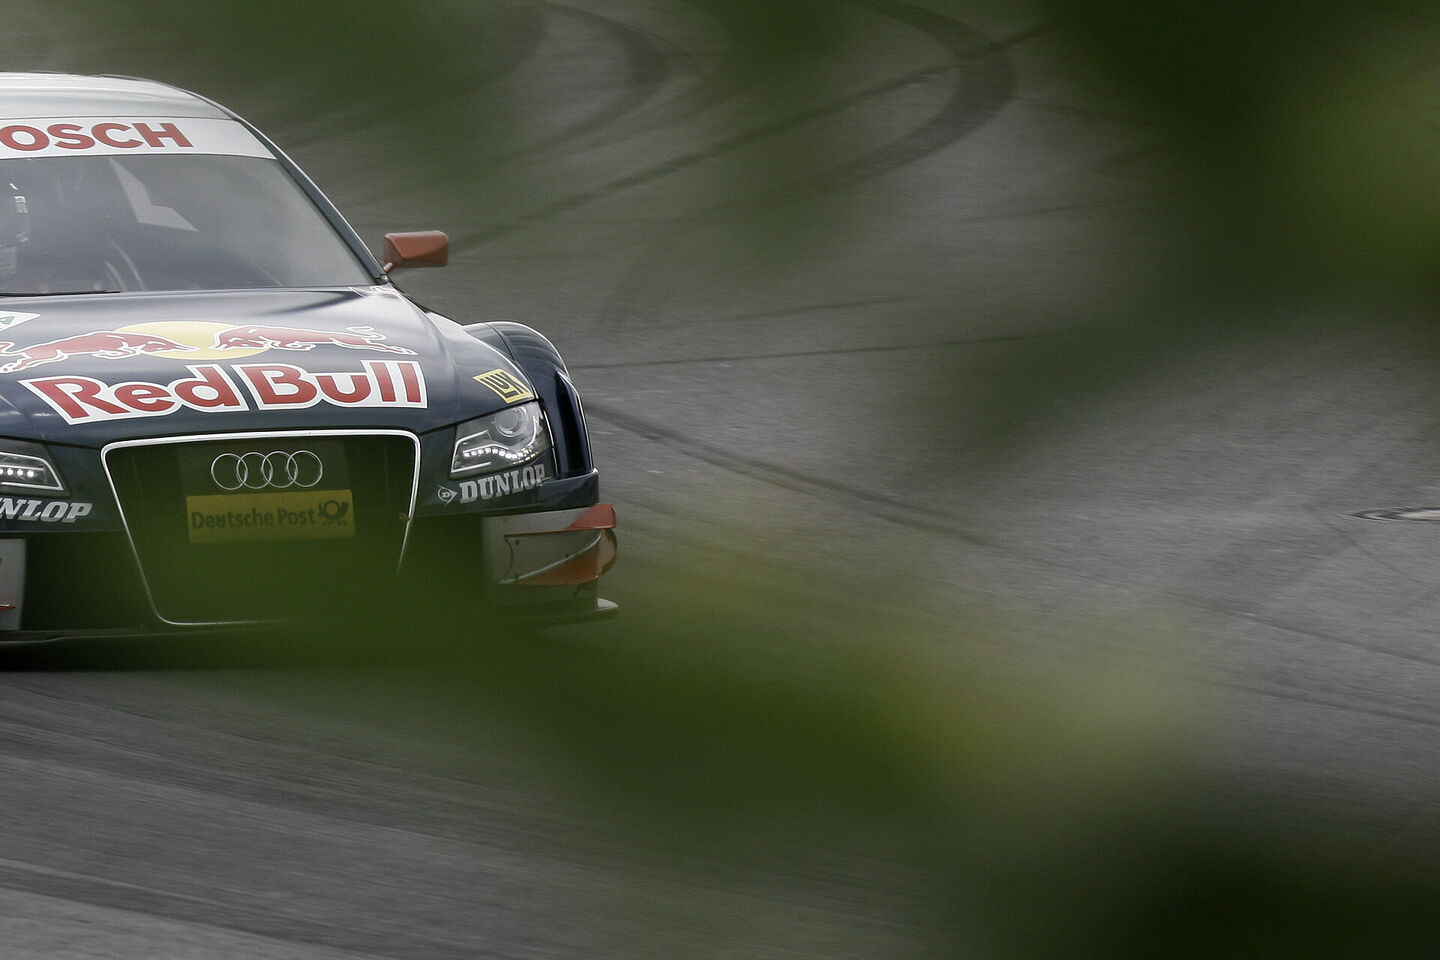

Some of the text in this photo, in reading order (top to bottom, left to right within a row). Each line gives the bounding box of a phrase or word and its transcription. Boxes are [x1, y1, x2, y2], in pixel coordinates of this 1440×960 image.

[23, 361, 427, 423] Red Bull
[459, 463, 547, 505] DUNLOP
[191, 507, 316, 530] Deutsche Post
